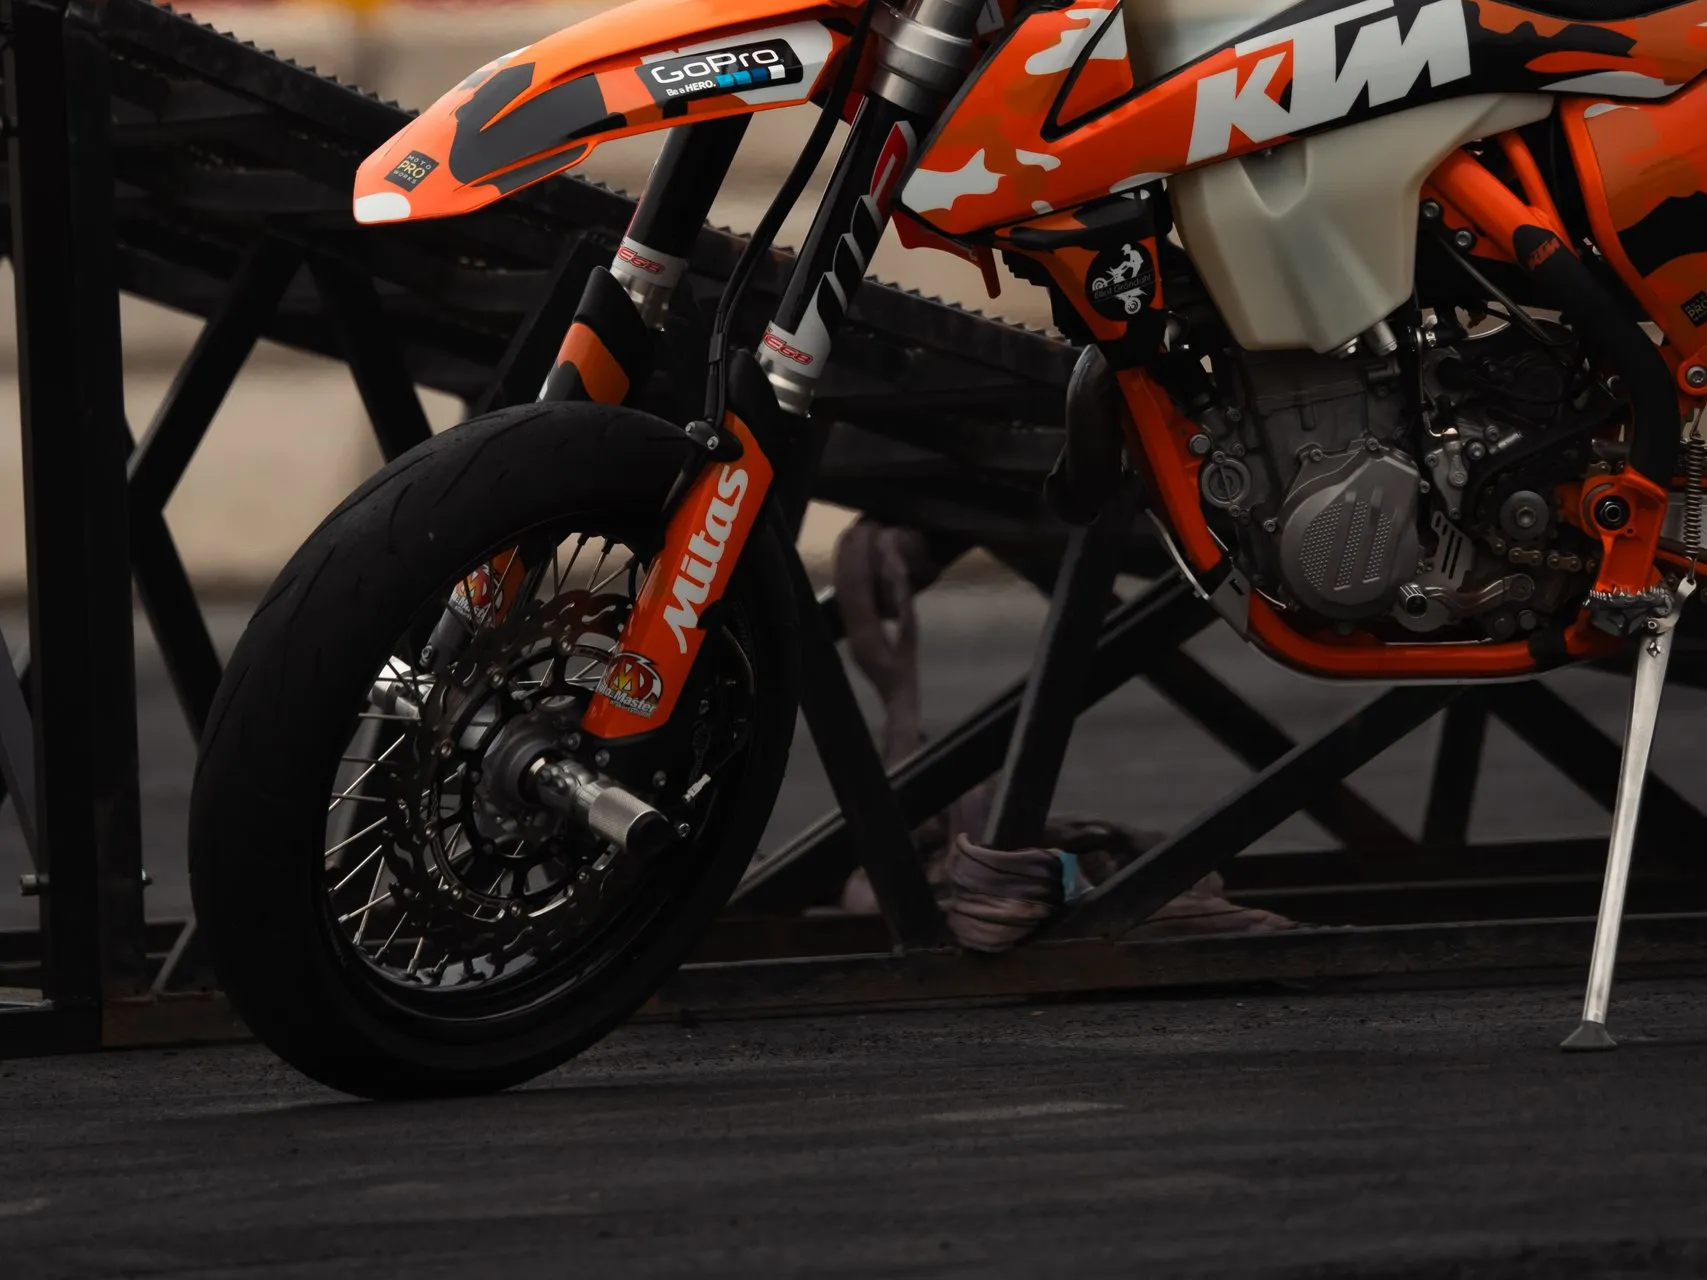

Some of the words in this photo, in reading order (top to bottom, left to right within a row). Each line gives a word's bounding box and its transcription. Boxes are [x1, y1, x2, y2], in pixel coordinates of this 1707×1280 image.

[650, 48, 780, 84] GoPro
[665, 88, 679, 97] Be
[679, 87, 686, 95] a
[685, 80, 717, 93] HERO.
[396, 159, 426, 179] PRO
[406, 154, 432, 170] MOTO
[392, 169, 418, 185] WORKS
[662, 463, 750, 655] Mitas
